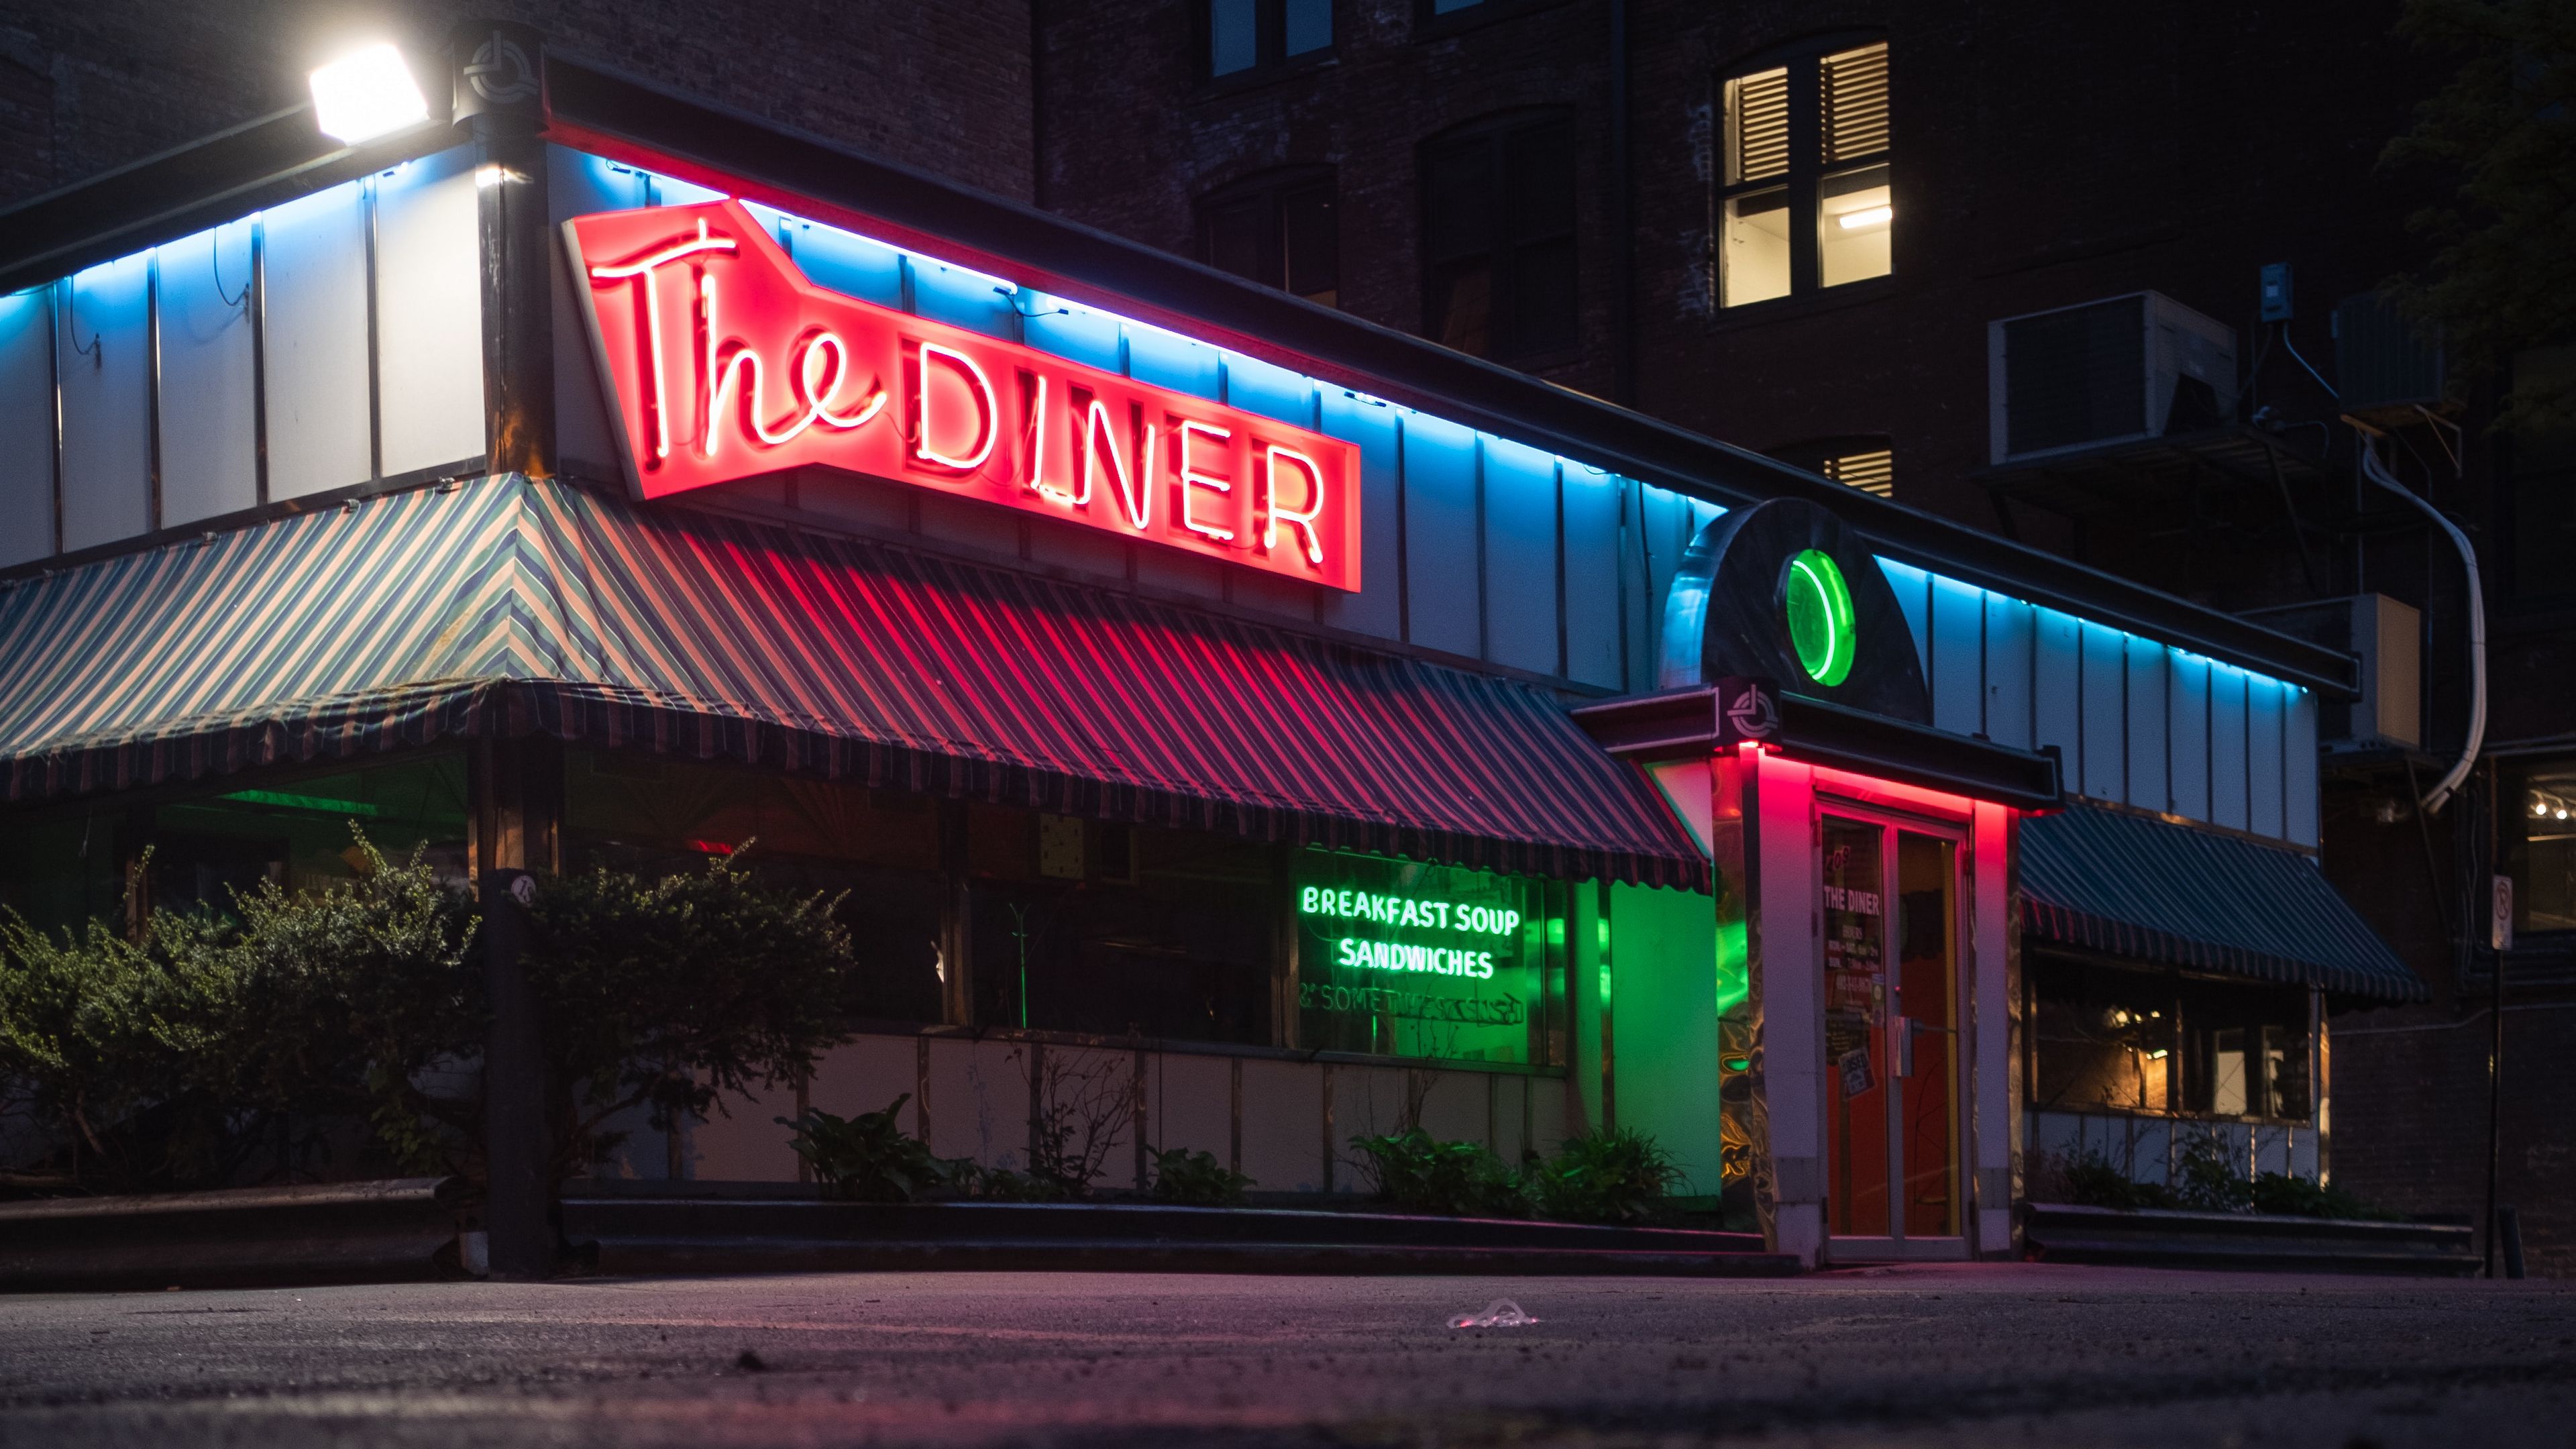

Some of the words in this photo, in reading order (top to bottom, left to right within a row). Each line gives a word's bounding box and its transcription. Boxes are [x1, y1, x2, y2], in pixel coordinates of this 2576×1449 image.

[590, 217, 889, 458] The
[916, 341, 1325, 564] DINER
[1302, 886, 1450, 929] BREAKFAST
[1454, 903, 1519, 936] SOUP
[1824, 885, 1845, 910] THE
[1847, 890, 1880, 916] DINER
[1338, 937, 1494, 979] SANDWICHES
